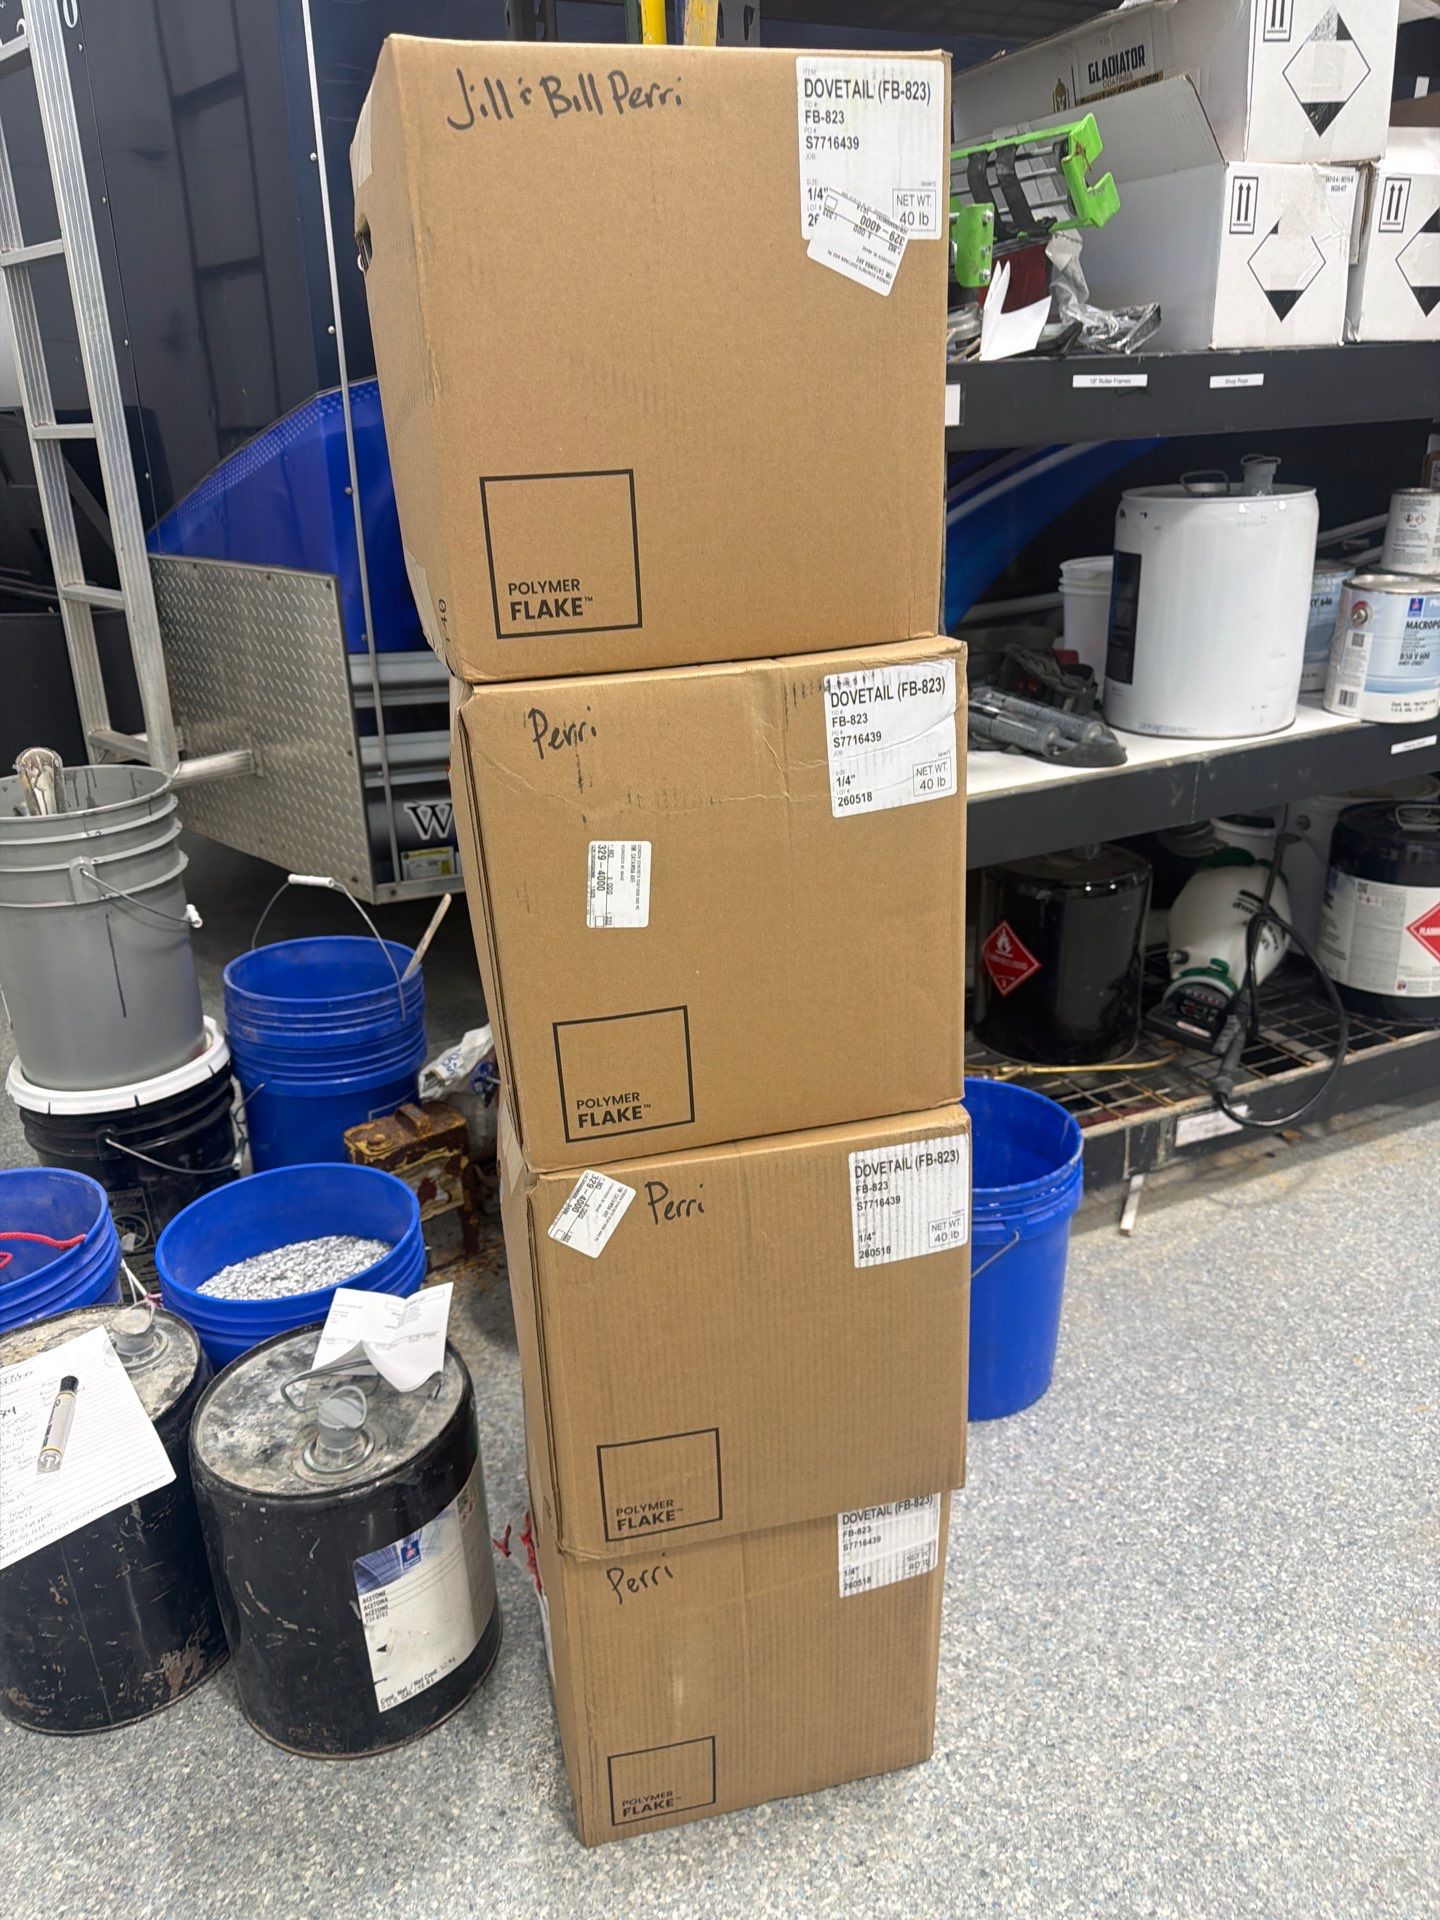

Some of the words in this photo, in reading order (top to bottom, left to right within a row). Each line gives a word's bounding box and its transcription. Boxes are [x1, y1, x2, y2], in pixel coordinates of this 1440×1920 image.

[1087, 44, 1146, 85] GLADIATOR
[446, 68, 514, 131] Jill
[540, 72, 604, 120] Bill
[610, 68, 684, 117] Perri
[804, 78, 874, 100] DOVETAIL
[877, 80, 931, 106] (FB-823)
[804, 109, 845, 125] FB-823
[805, 135, 860, 151] S7716439
[896, 194, 914, 208] NET
[860, 214, 881, 234] 4000
[900, 211, 914, 226] 40
[918, 211, 930, 226] lb
[889, 230, 906, 247] 329
[508, 578, 581, 596] POLYMER
[830, 684, 894, 708] DOVETAIL
[897, 676, 946, 702] (FB-823)
[832, 713, 868, 728] FB-823
[528, 705, 597, 760] Perri
[833, 731, 882, 748] S7716439
[916, 765, 933, 777] NET
[836, 774, 856, 788] 1/4"
[919, 778, 934, 791] 40
[937, 776, 947, 788] lb
[838, 791, 873, 807] 260518
[597, 845, 607, 860] 329
[596, 871, 606, 892] 4000
[576, 1091, 640, 1110] POLYMER
[855, 1157, 912, 1179] DOVETAIL
[915, 1149, 960, 1172] (FB-823)
[586, 1173, 600, 1190] 329
[856, 1181, 889, 1195] FB-823
[571, 1194, 587, 1214] 4000
[644, 1181, 705, 1225] Perri
[857, 1195, 901, 1211] S7716439
[931, 1220, 948, 1232] NET
[934, 1231, 948, 1243] 40
[950, 1230, 960, 1240] lb
[859, 1246, 891, 1259] 260518
[616, 1499, 674, 1516] POLYMER
[842, 1505, 892, 1526] DOVETAIL
[895, 1494, 933, 1515] (FB-823)
[606, 1552, 674, 1605] Perri
[362, 1590, 387, 1604] ACETONE
[364, 1604, 389, 1617] ACETONE
[622, 1790, 674, 1807] POLYMER
